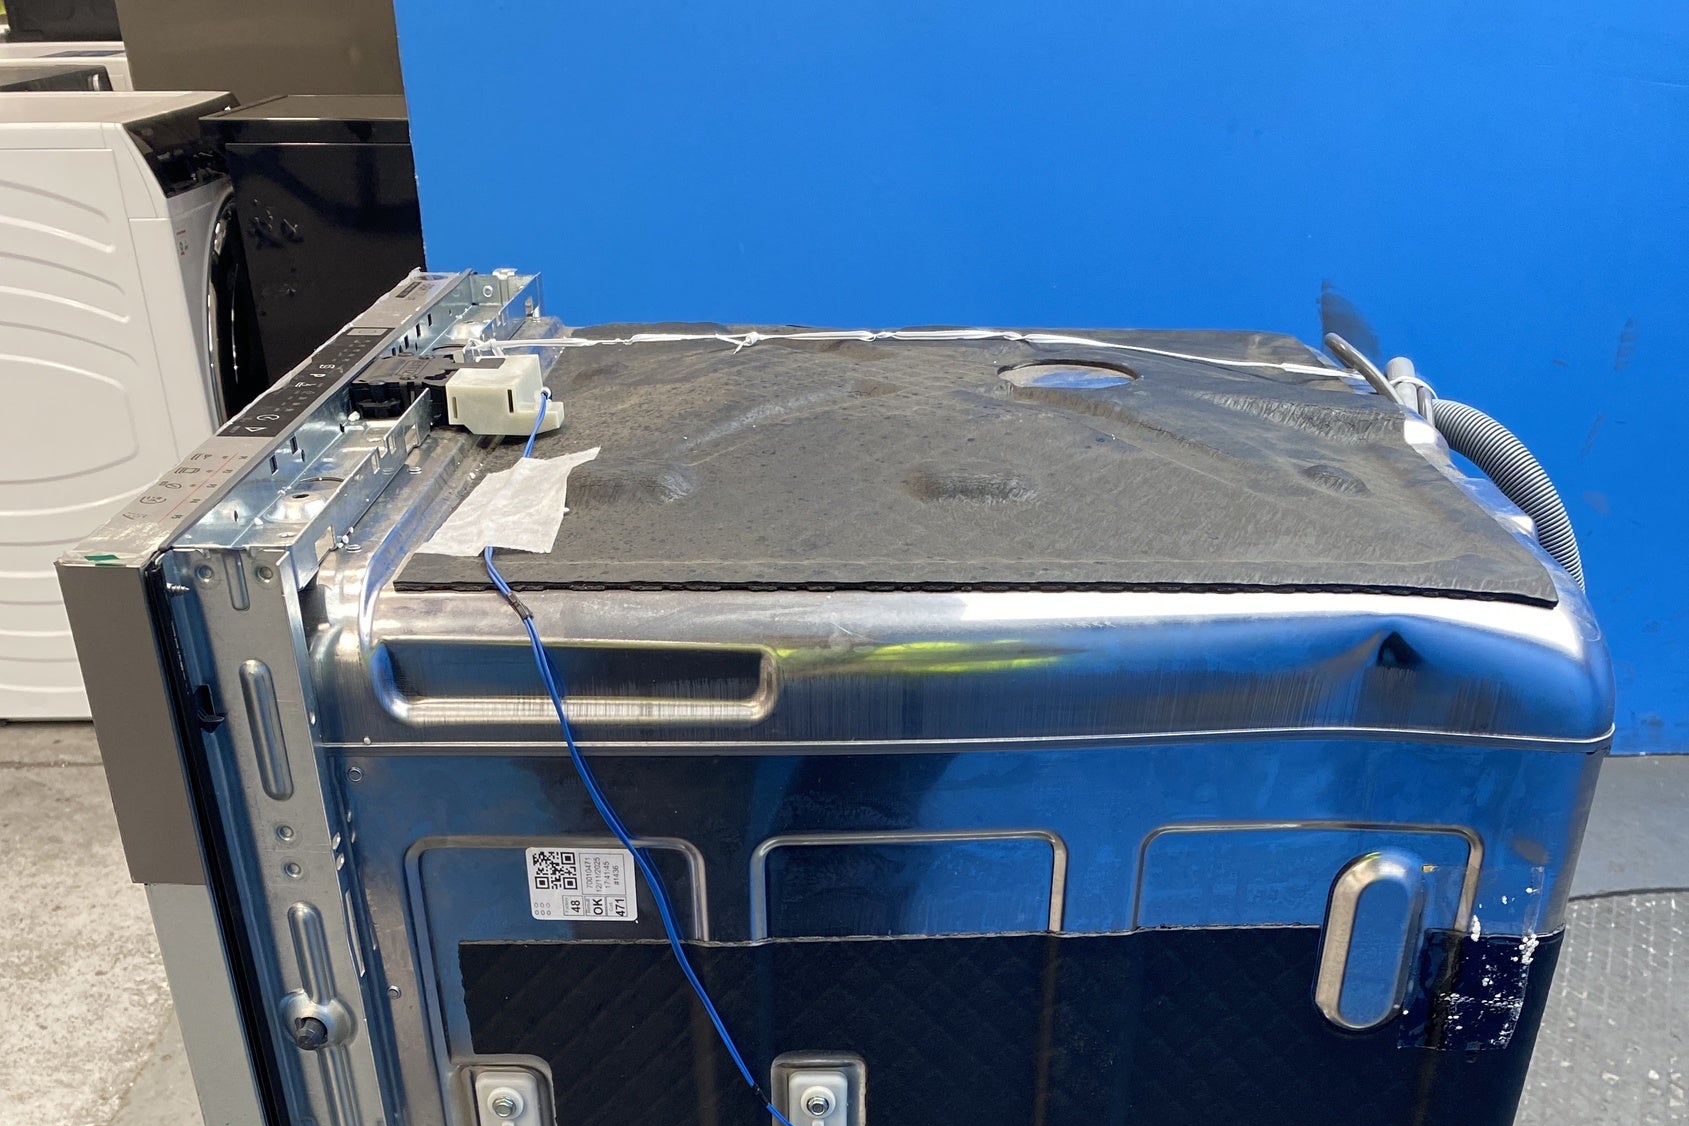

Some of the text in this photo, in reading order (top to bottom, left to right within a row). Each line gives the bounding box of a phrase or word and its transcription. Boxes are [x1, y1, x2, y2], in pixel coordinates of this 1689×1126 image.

[584, 857, 593, 889] 70010471
[593, 856, 603, 892] 12/11/2025
[603, 861, 612, 888] 17:41:45
[612, 865, 620, 886] #1436
[570, 900, 581, 913] 48
[592, 898, 604, 916] OK
[615, 898, 625, 917] 471
